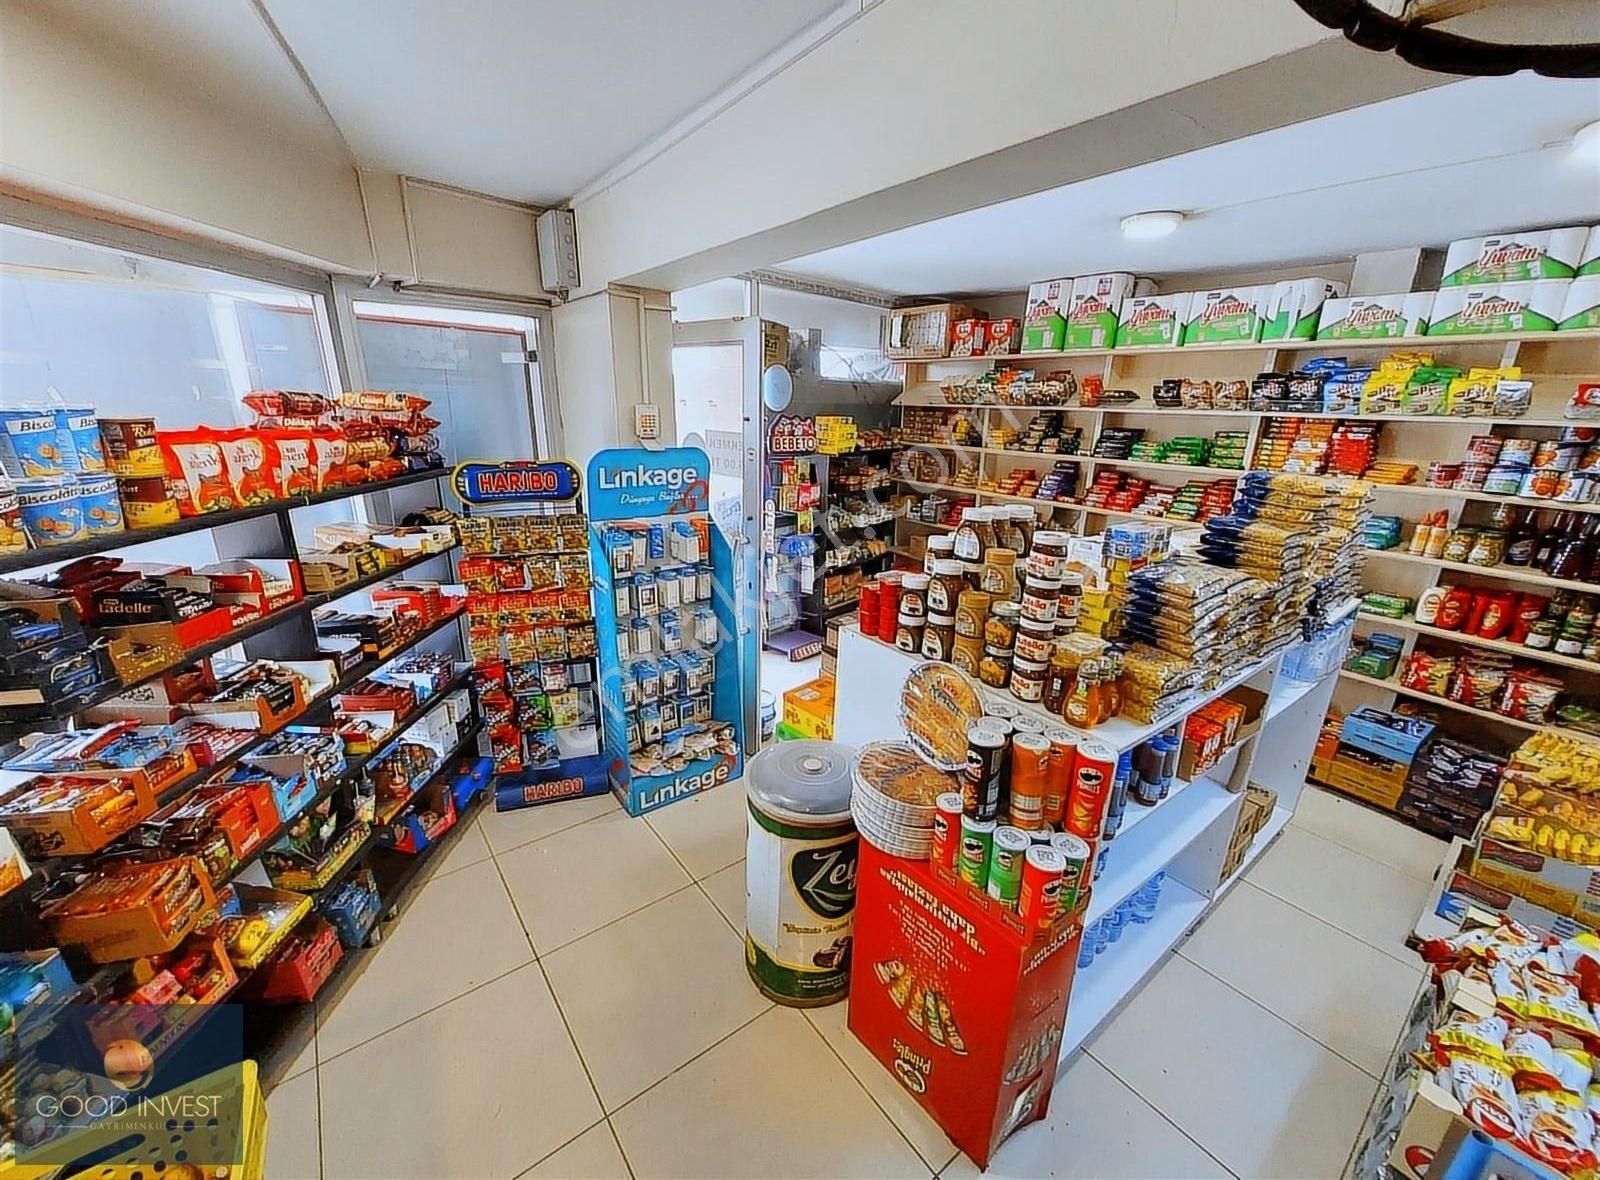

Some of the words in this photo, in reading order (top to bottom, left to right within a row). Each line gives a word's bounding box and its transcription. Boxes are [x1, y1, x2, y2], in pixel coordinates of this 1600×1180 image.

[774, 436, 817, 452] BEBETO
[478, 470, 558, 493] HARIBO
[599, 465, 698, 490] Linkage
[524, 777, 584, 803] HARIBO
[639, 762, 729, 810] Linkage
[893, 1037, 933, 1077] Pringles
